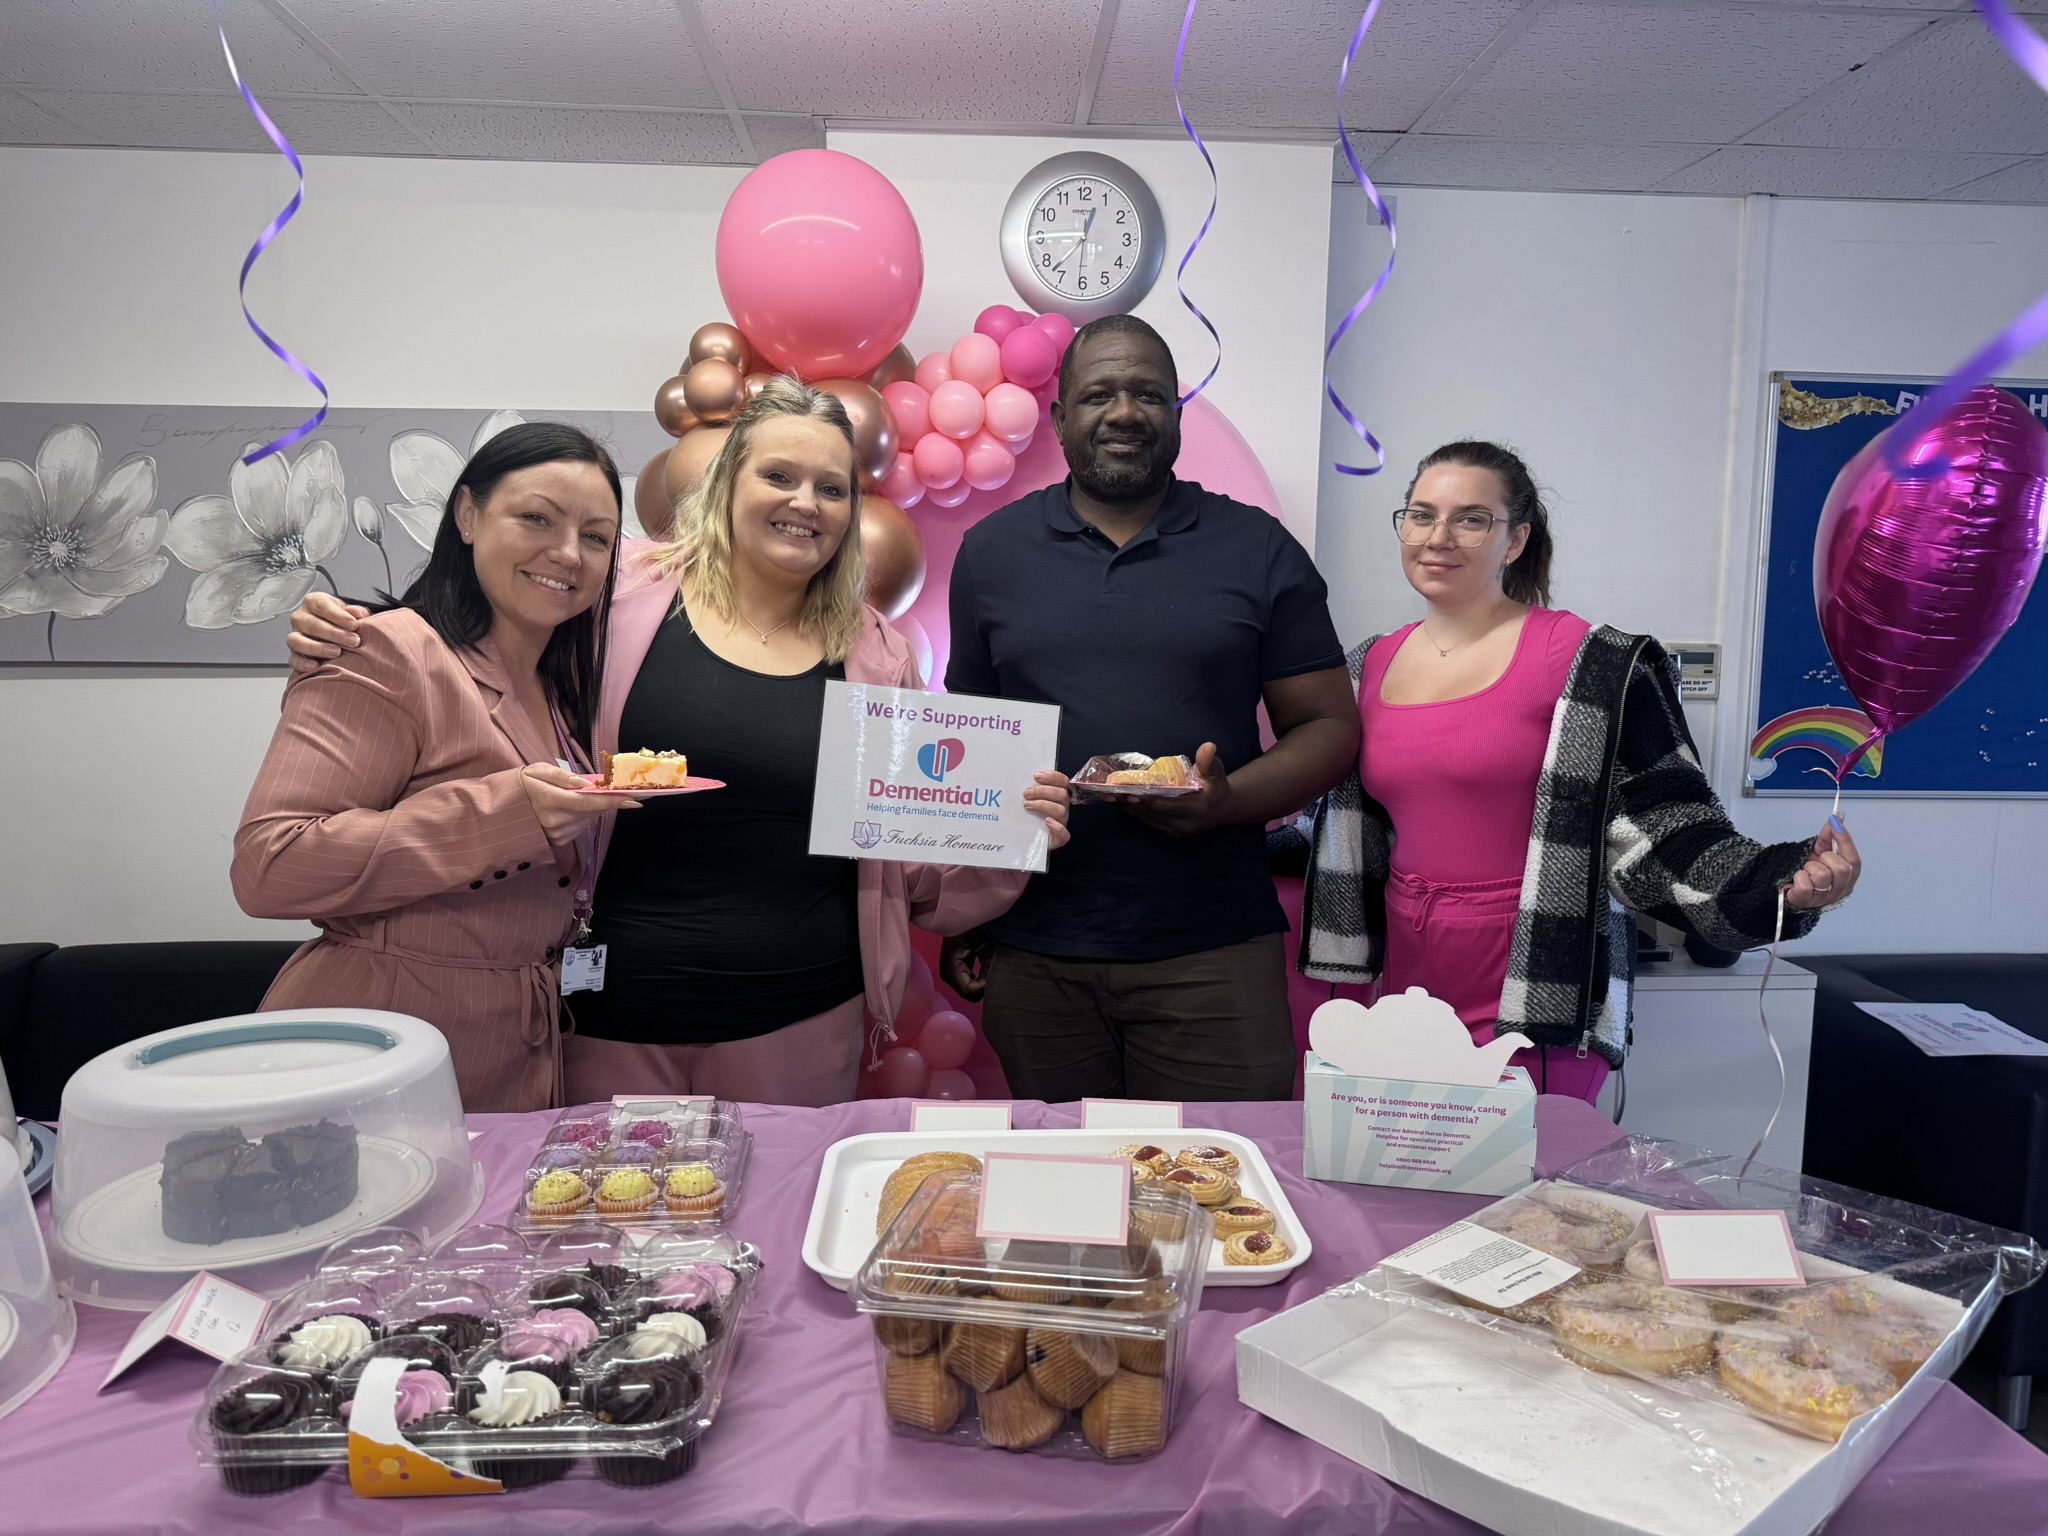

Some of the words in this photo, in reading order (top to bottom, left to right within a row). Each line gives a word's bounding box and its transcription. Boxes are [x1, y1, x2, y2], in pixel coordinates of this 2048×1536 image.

[1056, 191, 1069, 206] 11
[1077, 187, 1092, 201] 12
[1102, 193, 1108, 206] 1
[1041, 208, 1056, 222] 10
[1116, 210, 1125, 224] 2
[1035, 230, 1045, 245] 9
[1122, 233, 1131, 247] 3
[1042, 253, 1051, 267] 8
[1114, 255, 1123, 269] 4
[1057, 270, 1066, 284] 7
[1078, 276, 1088, 290] 6
[1100, 271, 1110, 285] 5
[922, 707, 1022, 736] Supporting
[866, 803, 901, 816] Helping
[901, 805, 937, 817] families
[938, 808, 957, 818] face
[958, 810, 999, 822] dementia
[883, 829, 938, 848] Fuchsia
[940, 834, 1005, 852] Homecare
[1331, 1092, 1346, 1101] Are
[1347, 1095, 1367, 1105] you,
[1379, 1096, 1387, 1105] is
[1388, 1099, 1429, 1108] someone
[1430, 1101, 1447, 1110] you
[1448, 1102, 1476, 1113] know,
[1477, 1105, 1506, 1117] caring
[1355, 1105, 1369, 1114] for
[1376, 1109, 1408, 1118] person
[1409, 1111, 1429, 1120] with
[1431, 1113, 1479, 1124] dementia?
[1367, 1125, 1391, 1133] Contact
[1443, 1131, 1471, 1139] Dementia
[1376, 1133, 1399, 1141] Helpline
[1409, 1136, 1437, 1144] specialist
